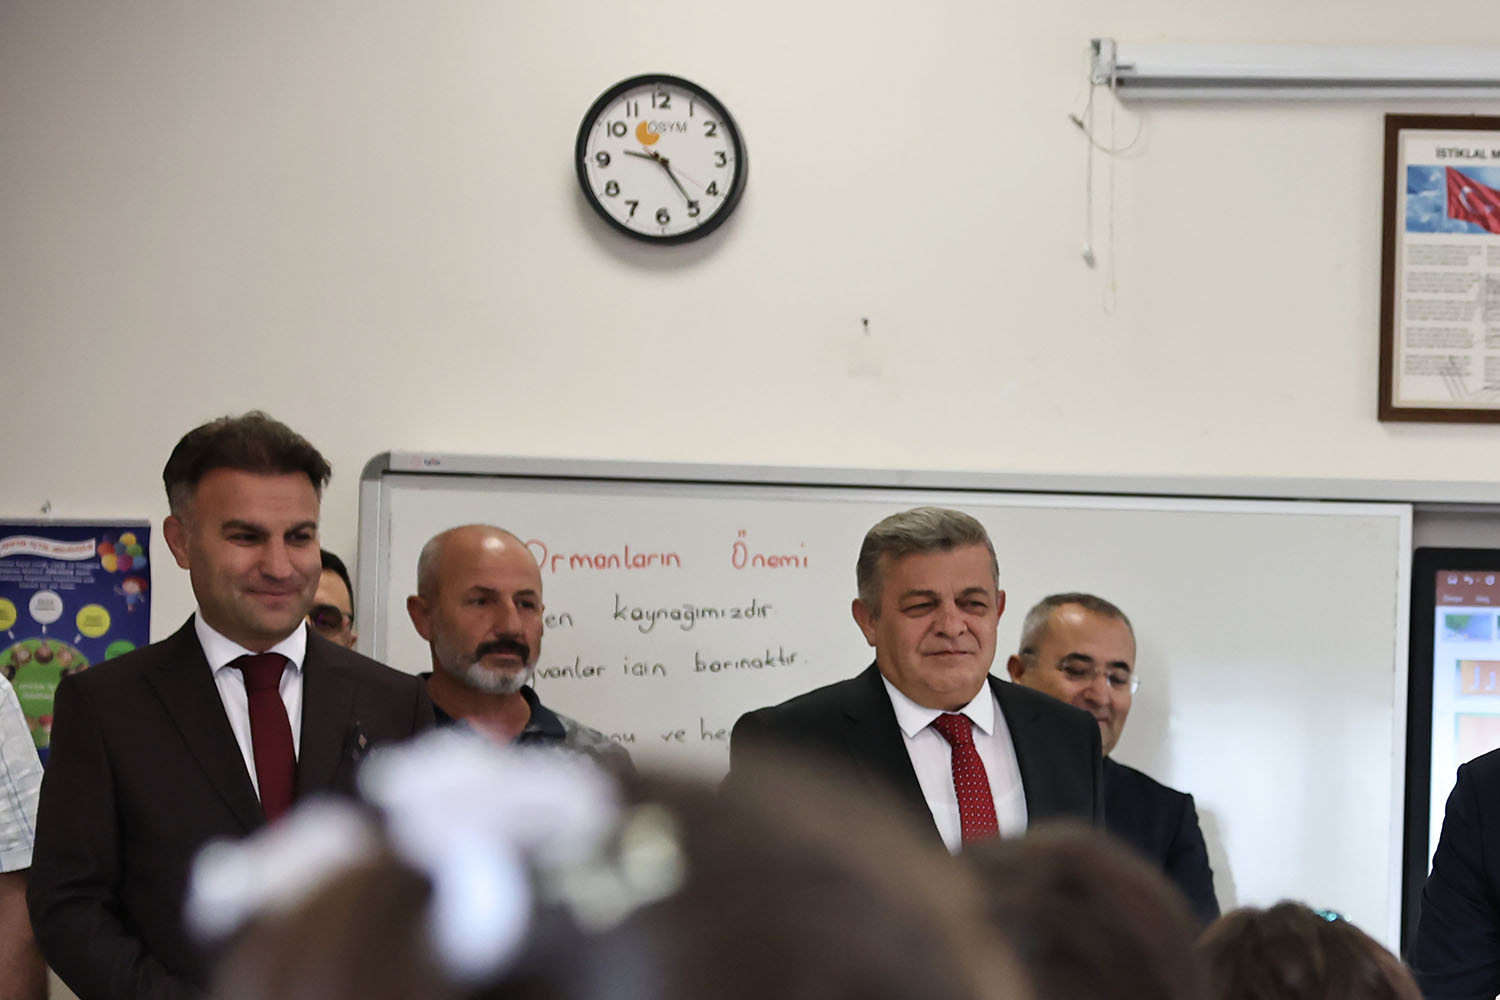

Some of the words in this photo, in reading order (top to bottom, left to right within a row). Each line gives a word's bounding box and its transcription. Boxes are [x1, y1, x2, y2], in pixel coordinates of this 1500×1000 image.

[626, 100, 638, 118] 11
[652, 92, 671, 109] 12
[689, 100, 694, 117] 1
[607, 121, 627, 138] 10
[703, 121, 717, 137] 2
[596, 152, 611, 168] 9
[714, 152, 727, 168] 3
[605, 180, 620, 196] 8
[705, 180, 719, 196] 4
[625, 200, 639, 217] 7
[656, 207, 670, 225] 6
[688, 200, 700, 218] 5
[525, 539, 681, 574] Ormanların
[732, 529, 808, 570] Önemi
[543, 612, 573, 629] en
